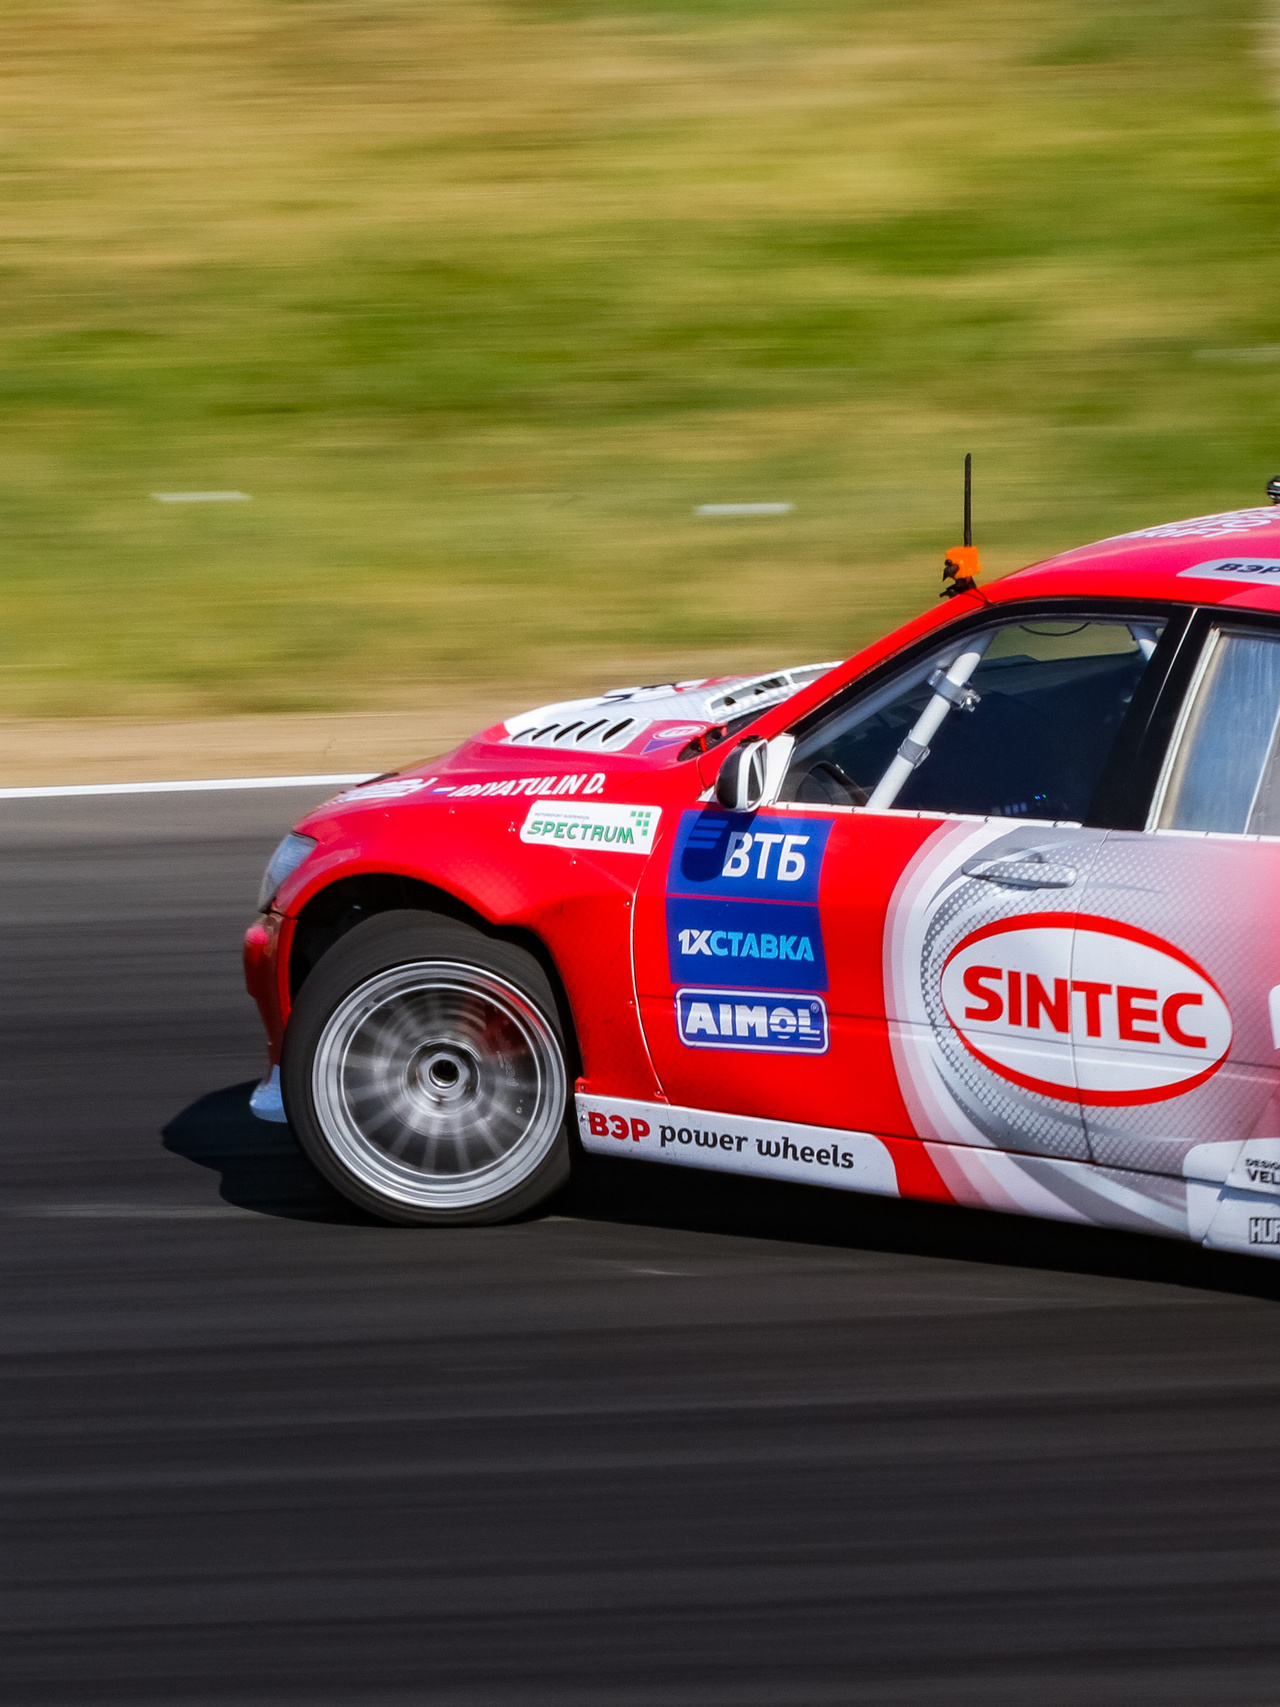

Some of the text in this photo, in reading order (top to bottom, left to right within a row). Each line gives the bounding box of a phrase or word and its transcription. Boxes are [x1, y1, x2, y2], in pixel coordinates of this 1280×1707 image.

[581, 772, 606, 795] D.
[527, 820, 635, 845] SPECTRUM
[722, 831, 810, 882] ВТБ
[685, 1002, 821, 1041] AIMOL
[961, 965, 1208, 1049] SINTEC
[587, 1111, 855, 1169] ВЭР power wheels
